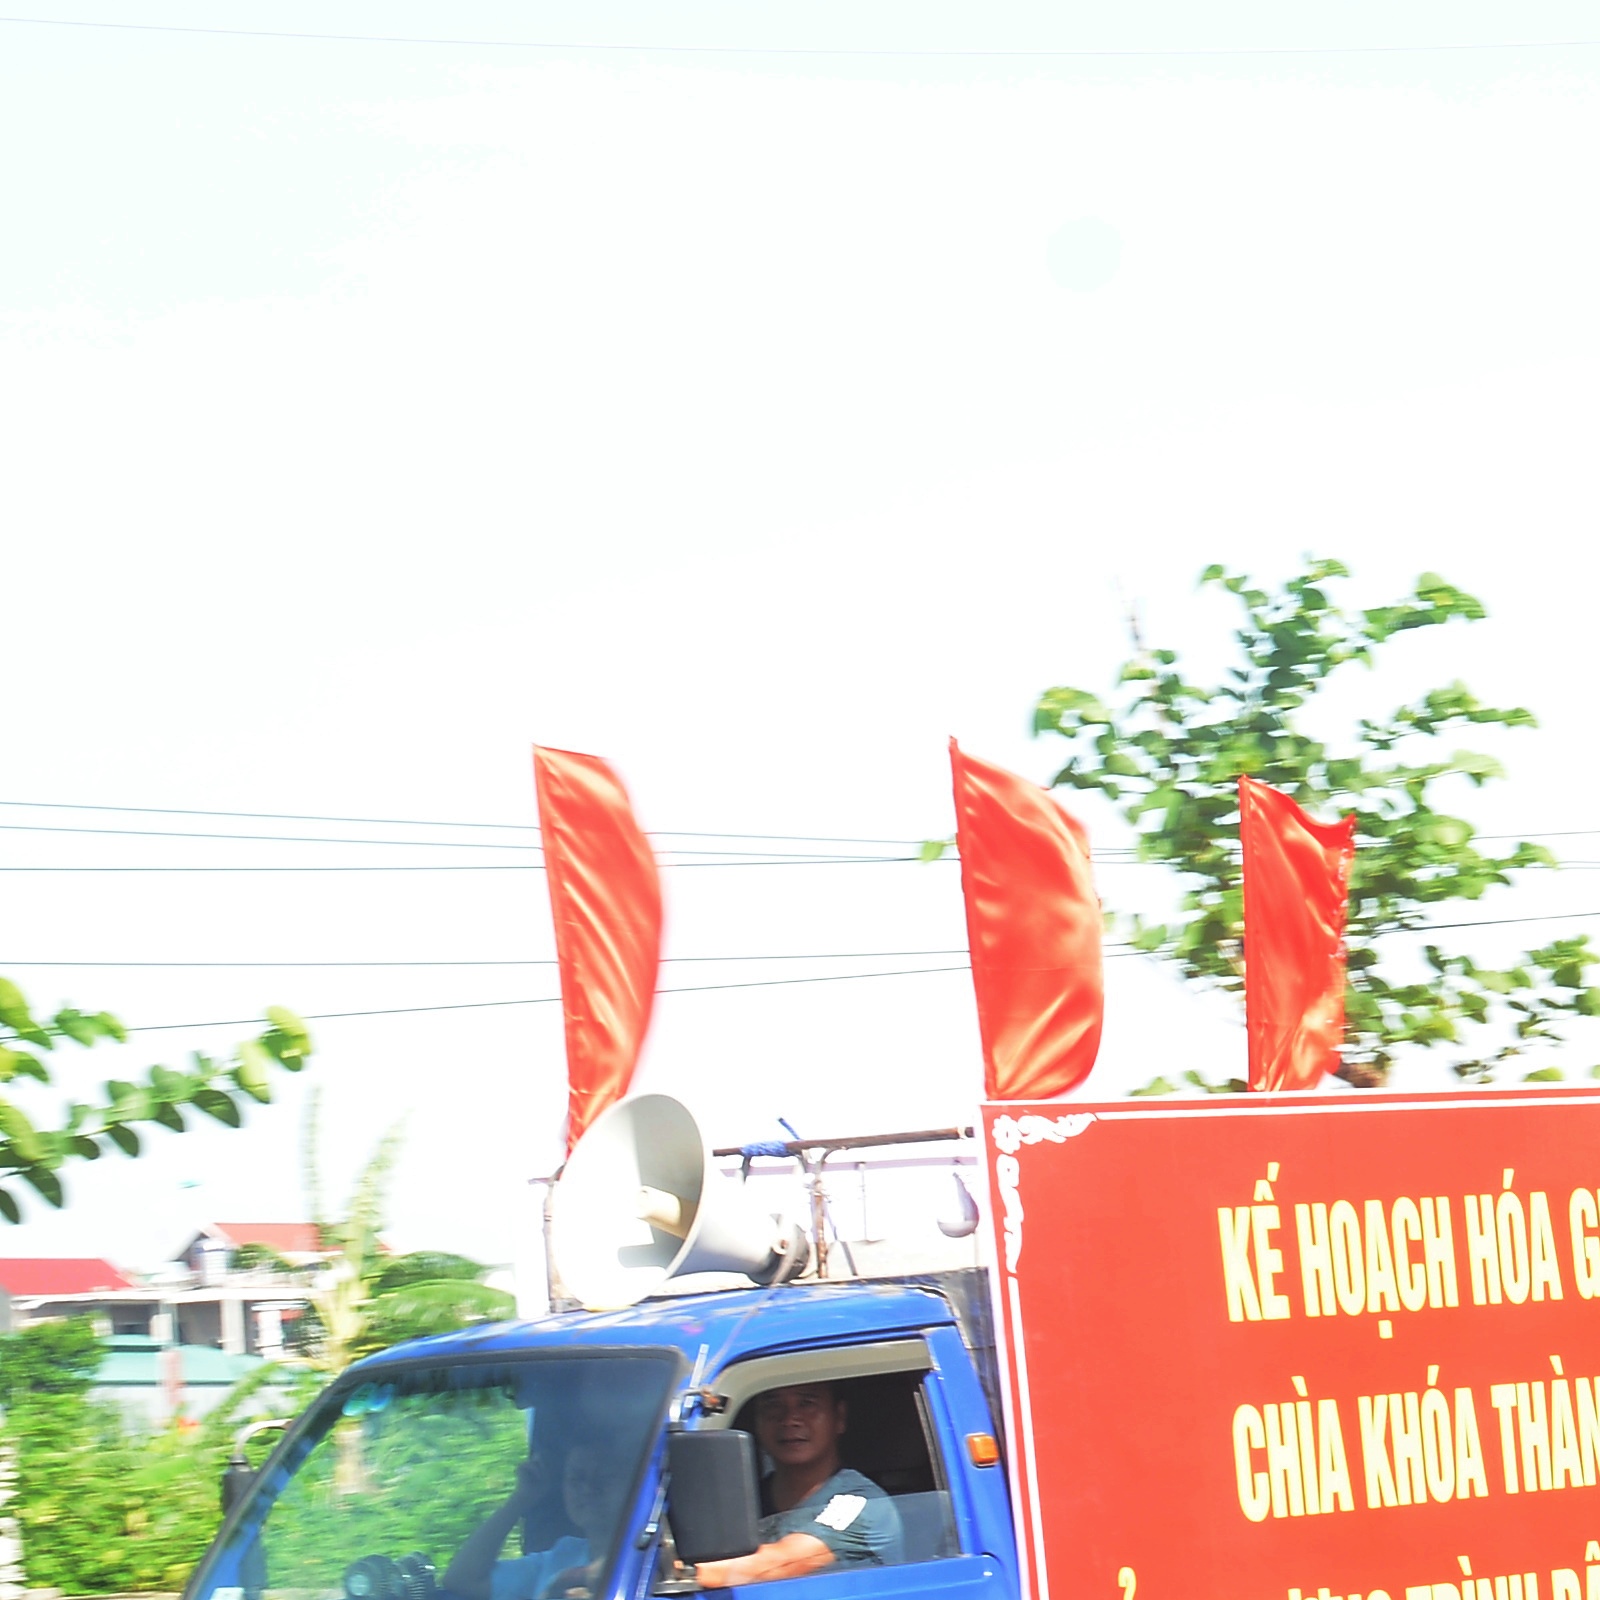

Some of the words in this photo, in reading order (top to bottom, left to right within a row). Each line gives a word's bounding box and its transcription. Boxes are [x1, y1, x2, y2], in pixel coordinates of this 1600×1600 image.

[1217, 1161, 1291, 1322] KẾ
[1295, 1195, 1459, 1340] HOẠCH
[1464, 1167, 1563, 1306] HÓA
[1231, 1375, 1355, 1522] CHÌA
[1358, 1364, 1489, 1509] KHÓA
